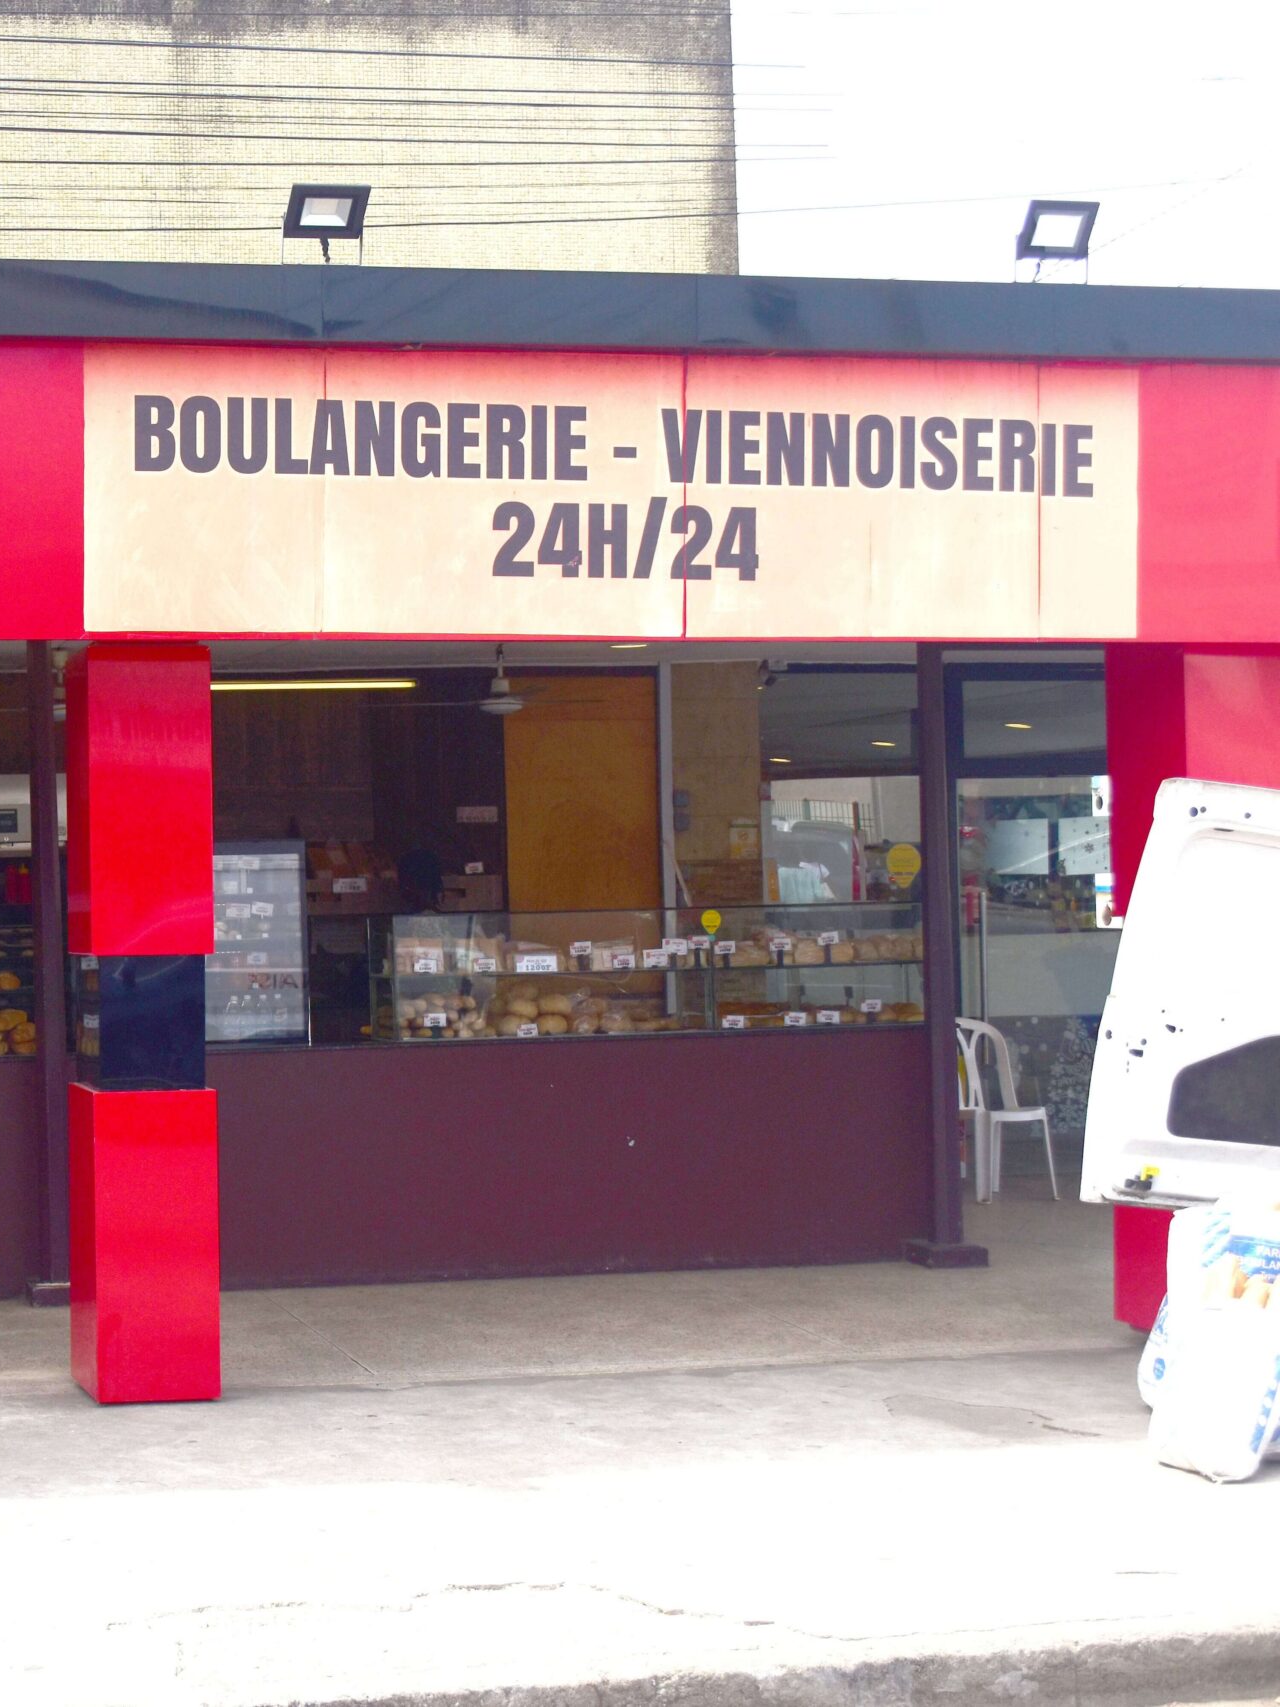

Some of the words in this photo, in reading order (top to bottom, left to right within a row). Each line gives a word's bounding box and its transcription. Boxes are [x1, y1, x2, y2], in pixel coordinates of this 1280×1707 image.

[134, 395, 588, 481] BOULANGERIE
[663, 408, 1094, 499] VIENNOISERIE
[494, 496, 759, 580] 24H/24
